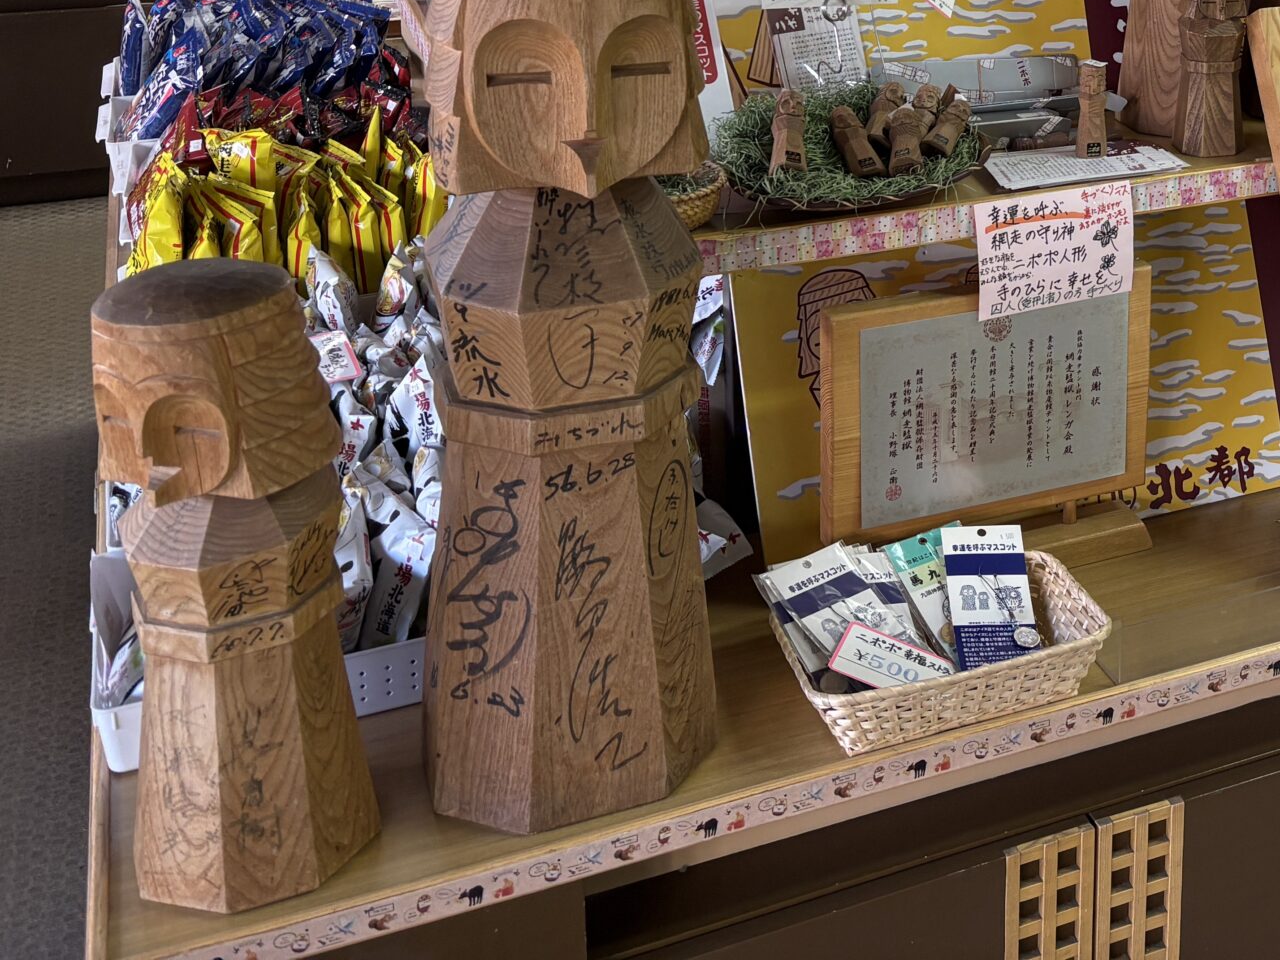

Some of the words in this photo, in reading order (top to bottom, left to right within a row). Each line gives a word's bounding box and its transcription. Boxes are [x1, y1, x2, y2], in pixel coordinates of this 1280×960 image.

[988, 200, 1069, 229] 幸運を呼ぶ、
[990, 221, 1075, 251] 網走の守り神
[1012, 244, 1088, 270] ニポポ人形
[997, 279, 1063, 301] 手のひらに
[1067, 270, 1108, 287] 幸せを
[1090, 365, 1102, 406] 感謝状
[1148, 446, 1256, 510] 北都
[951, 542, 1018, 553] 幸運を呼ぶマスコット
[787, 564, 848, 593] 幸運を呼ぶマスコット
[855, 633, 903, 654] ニポポ
